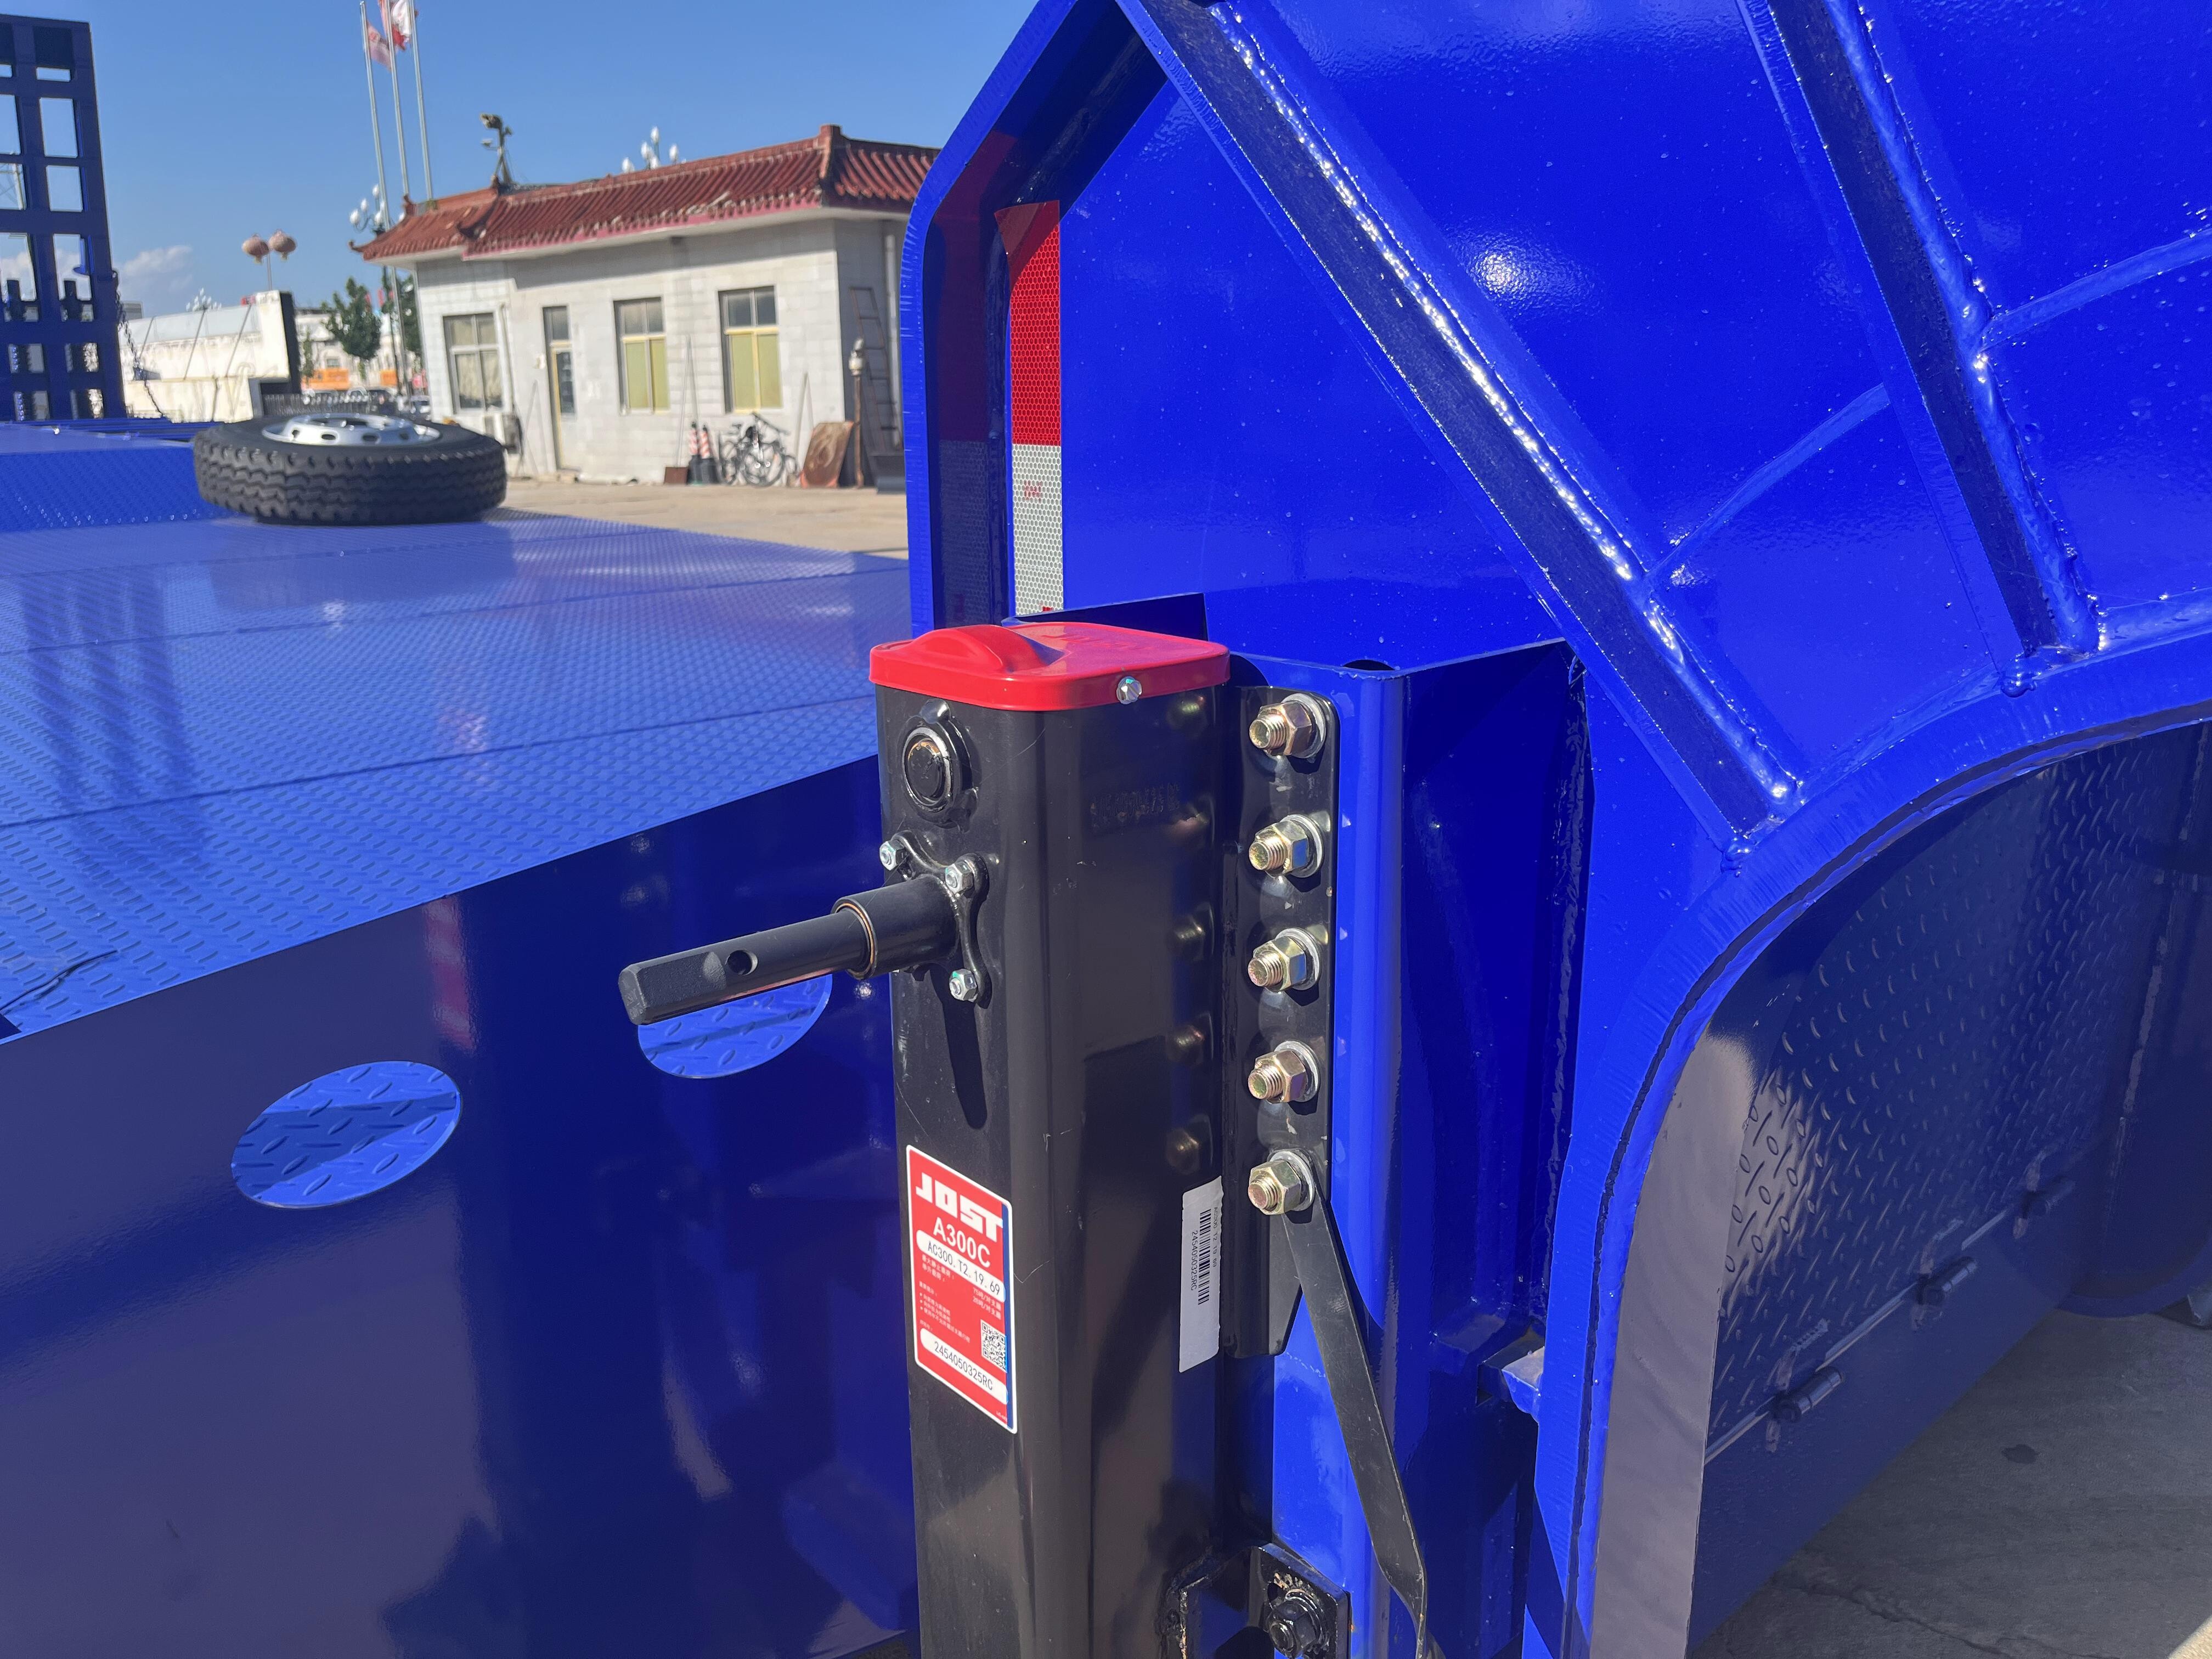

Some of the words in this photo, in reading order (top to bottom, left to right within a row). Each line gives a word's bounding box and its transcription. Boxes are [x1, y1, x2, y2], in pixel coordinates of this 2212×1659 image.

[916, 1172, 1003, 1242] JOST
[933, 1217, 990, 1267] A300C
[934, 1341, 993, 1390] 2454050325RC
